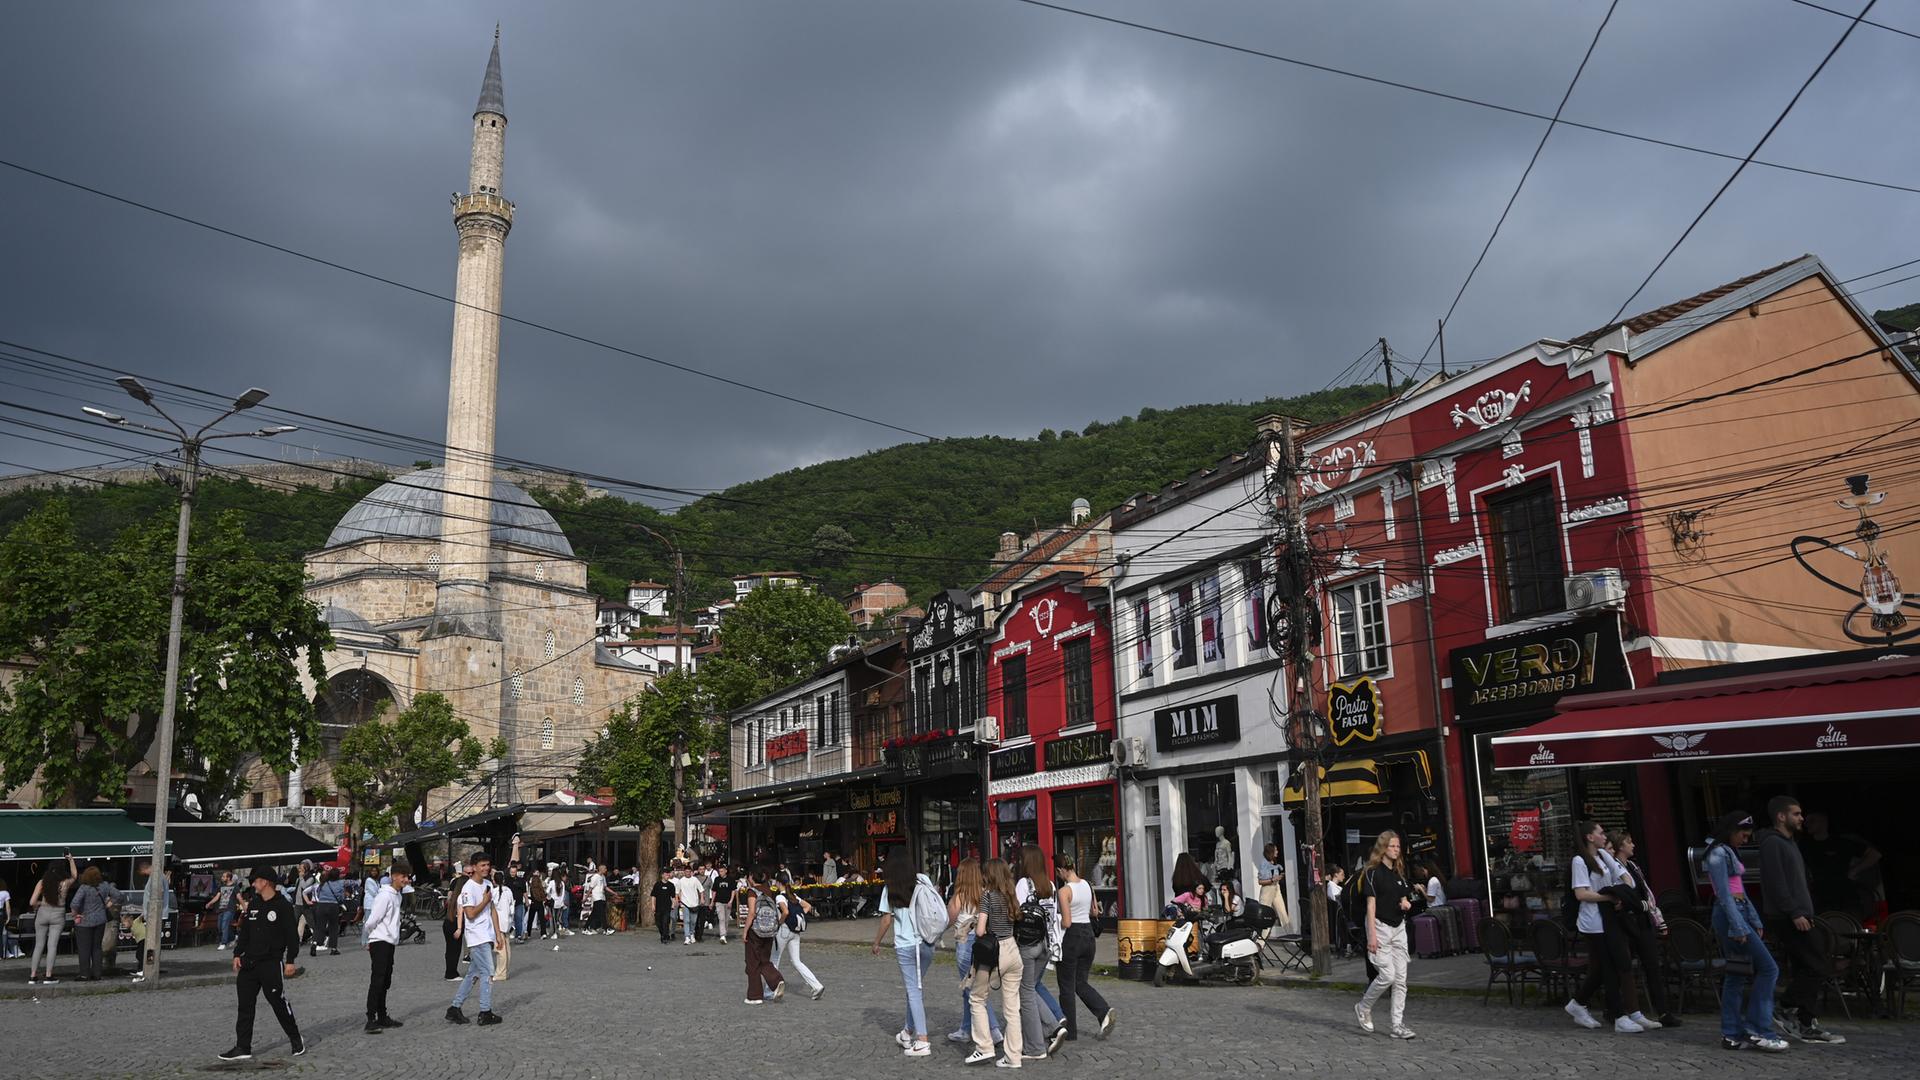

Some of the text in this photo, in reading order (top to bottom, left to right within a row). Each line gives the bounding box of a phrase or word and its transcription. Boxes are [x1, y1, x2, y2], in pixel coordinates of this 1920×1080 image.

[1481, 401, 1502, 419] 1931
[1462, 632, 1598, 687] VERDI
[1471, 673, 1576, 705] ACCESSORIES
[1335, 695, 1369, 720] Pasta
[1170, 704, 1218, 738] MIM
[1342, 713, 1368, 728] FASTA
[1197, 731, 1220, 741] FASHION
[1816, 731, 1848, 747] galla
[1529, 749, 1555, 765] galla
